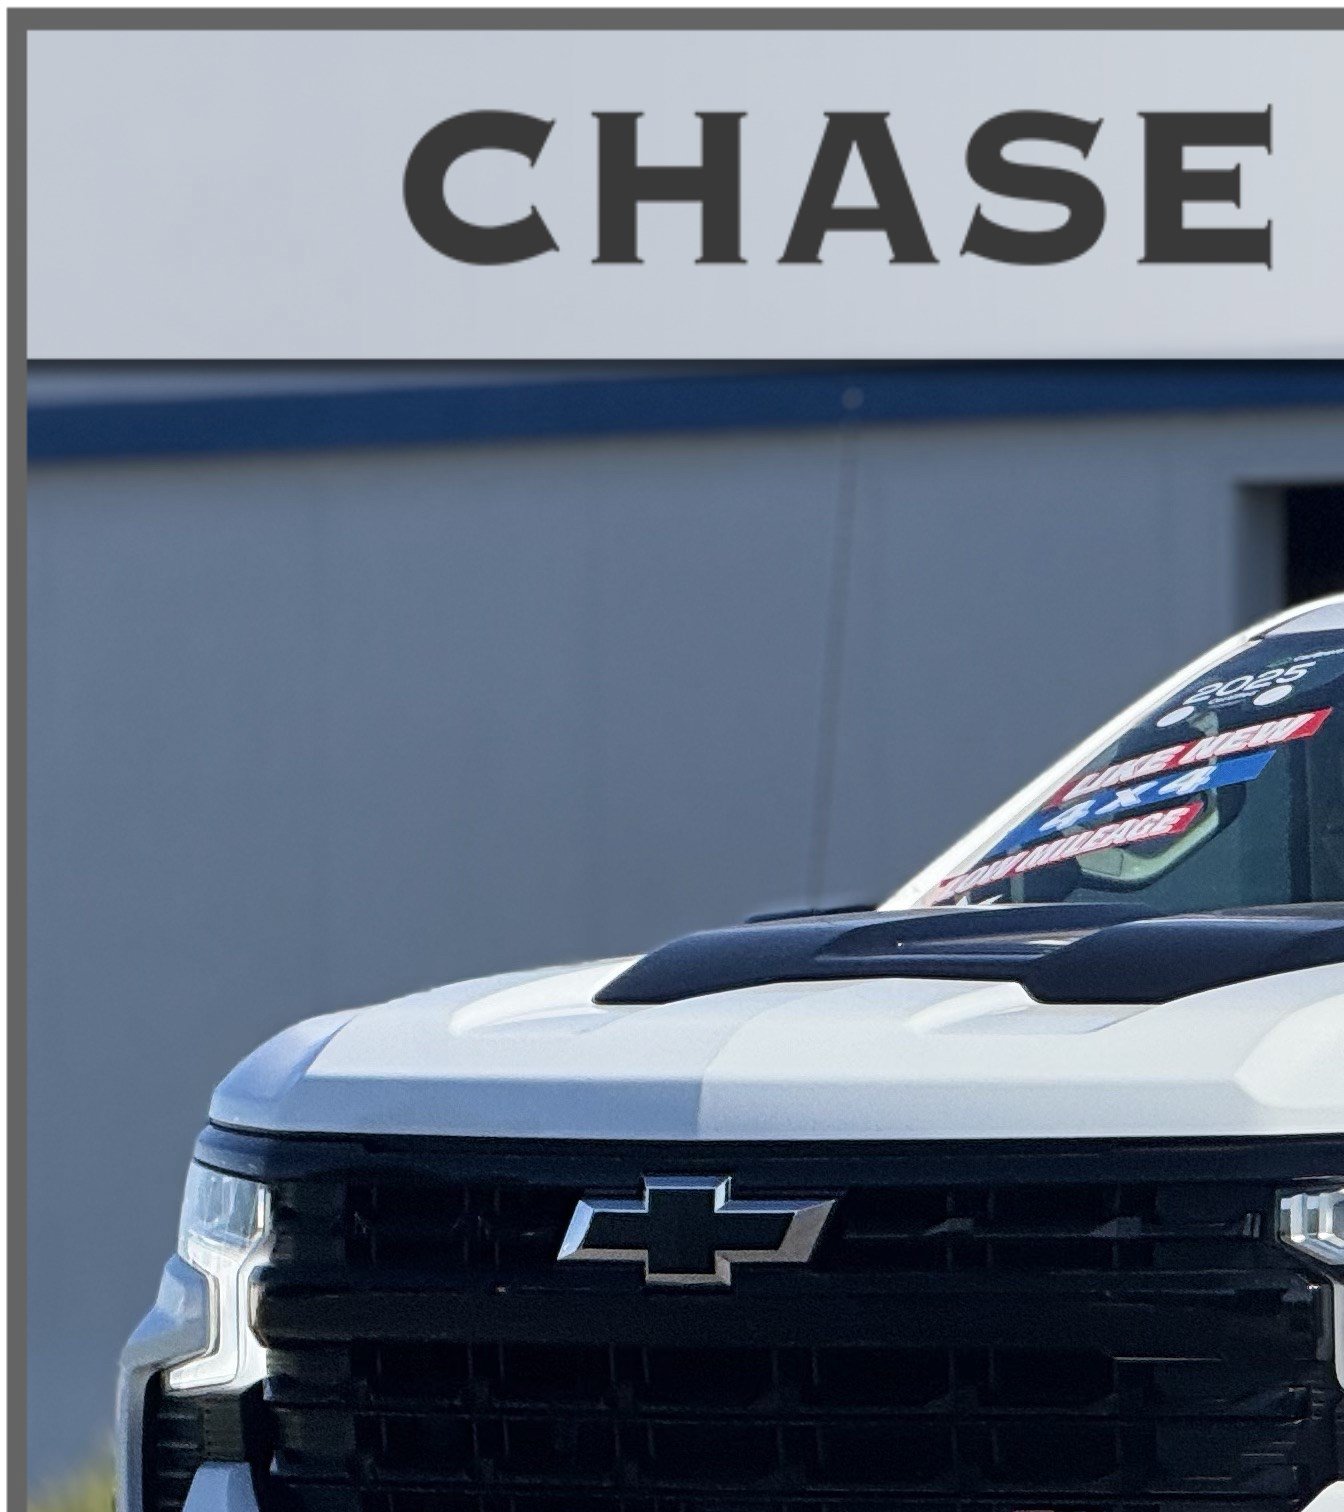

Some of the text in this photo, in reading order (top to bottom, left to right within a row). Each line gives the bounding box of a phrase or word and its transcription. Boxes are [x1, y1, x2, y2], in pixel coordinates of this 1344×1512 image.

[1183, 661, 1317, 706] 2025
[1060, 713, 1316, 802] LIKE NEW
[1014, 806, 1192, 874] MILEAGE
